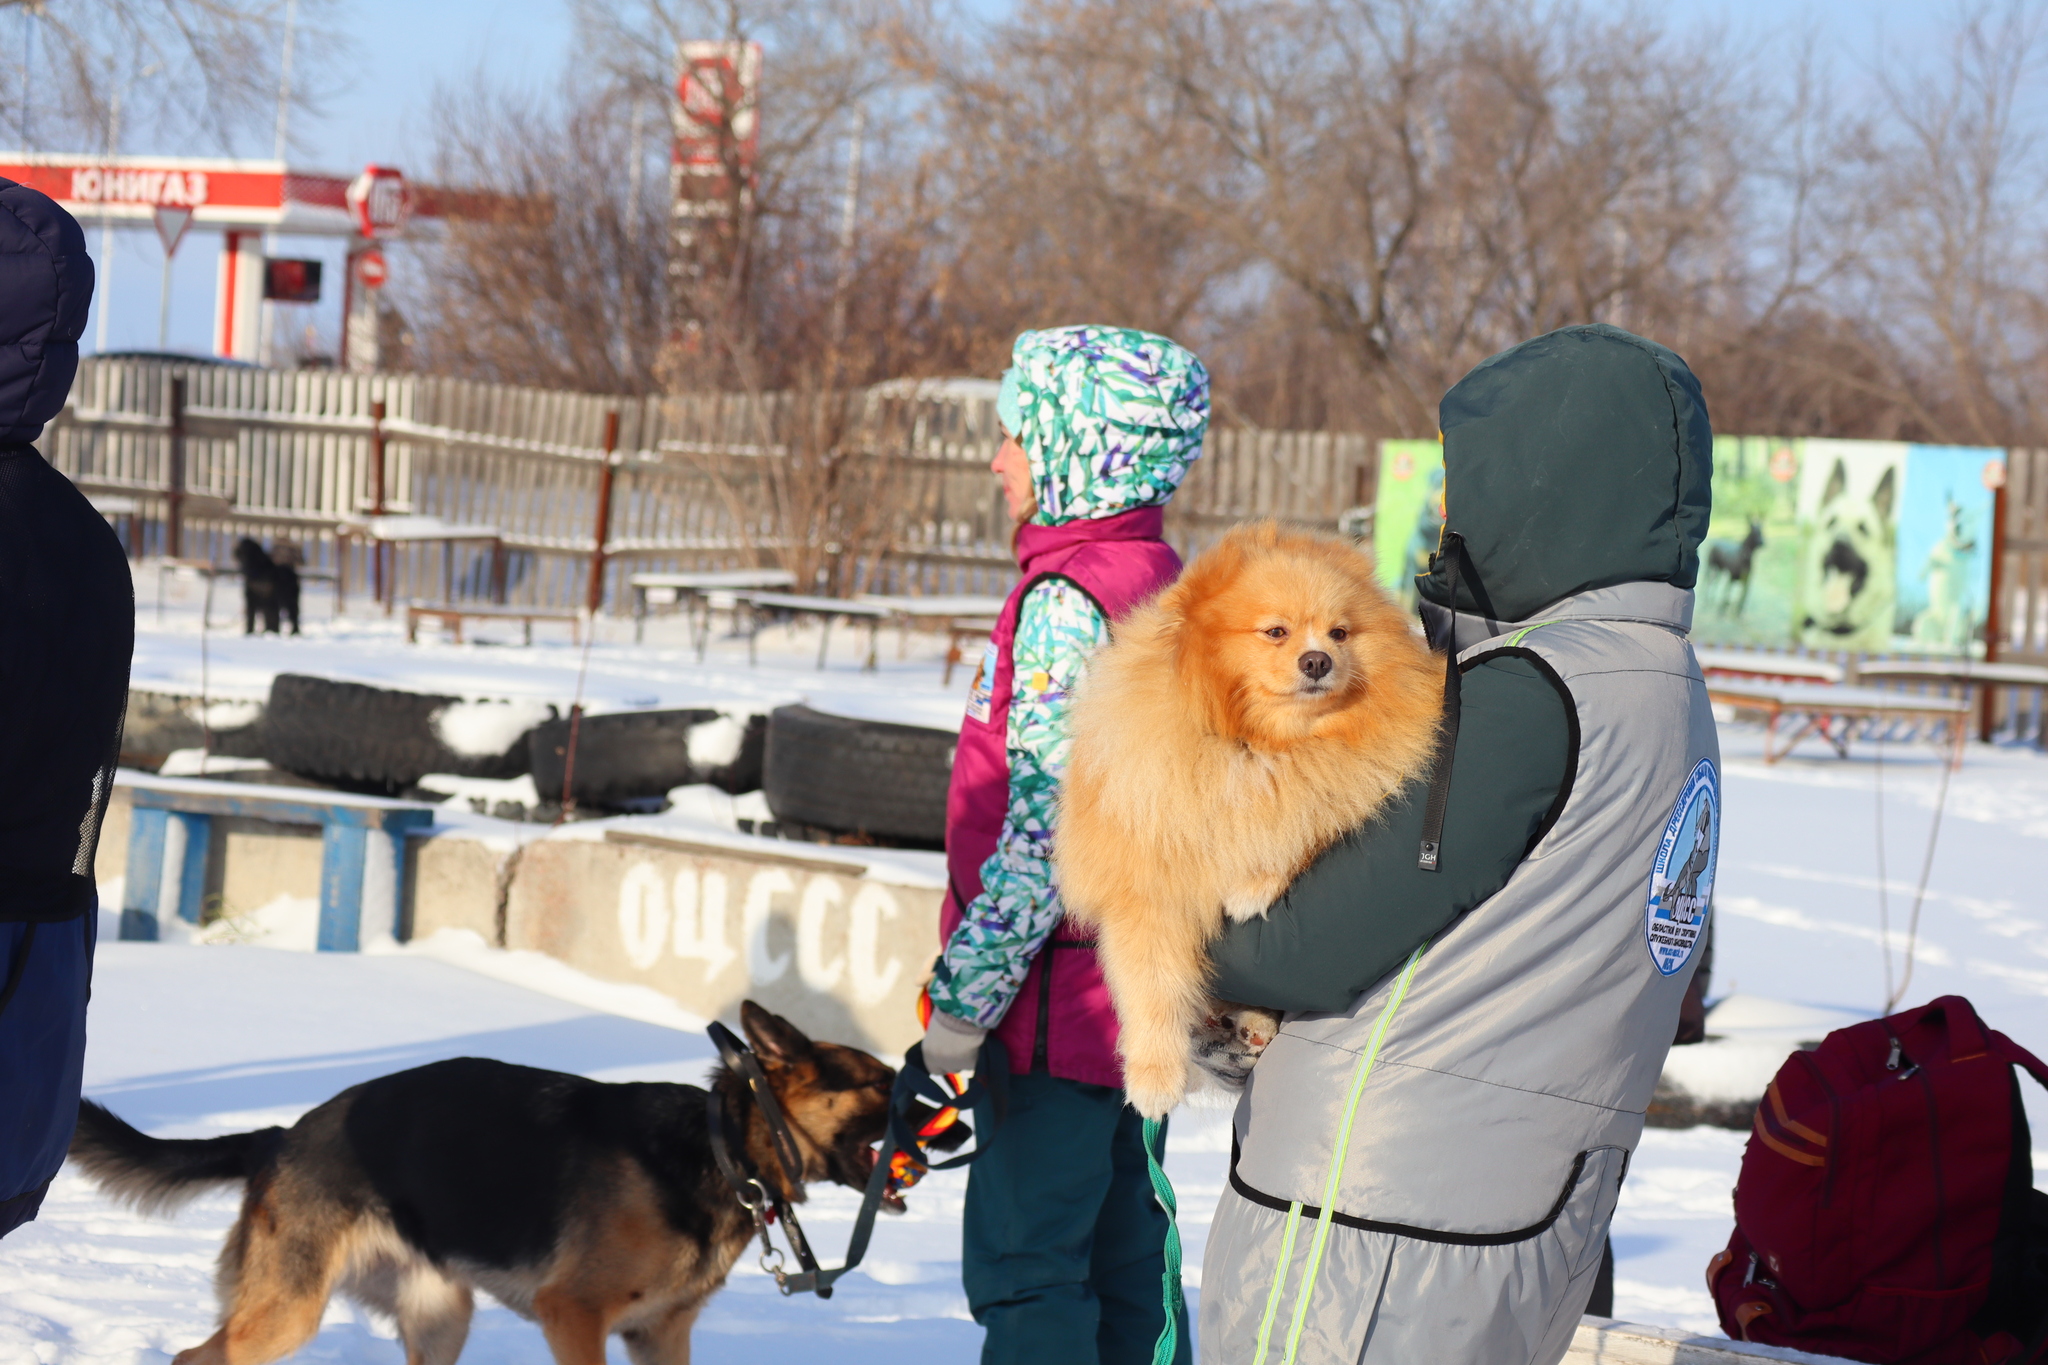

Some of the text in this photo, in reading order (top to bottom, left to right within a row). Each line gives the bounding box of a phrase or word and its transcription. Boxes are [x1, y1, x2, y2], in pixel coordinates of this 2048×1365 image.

[71, 167, 208, 205] ЮНИГАЗ
[1655, 839, 1672, 874] ШКОЛА
[618, 860, 903, 1008] ОЦССС
